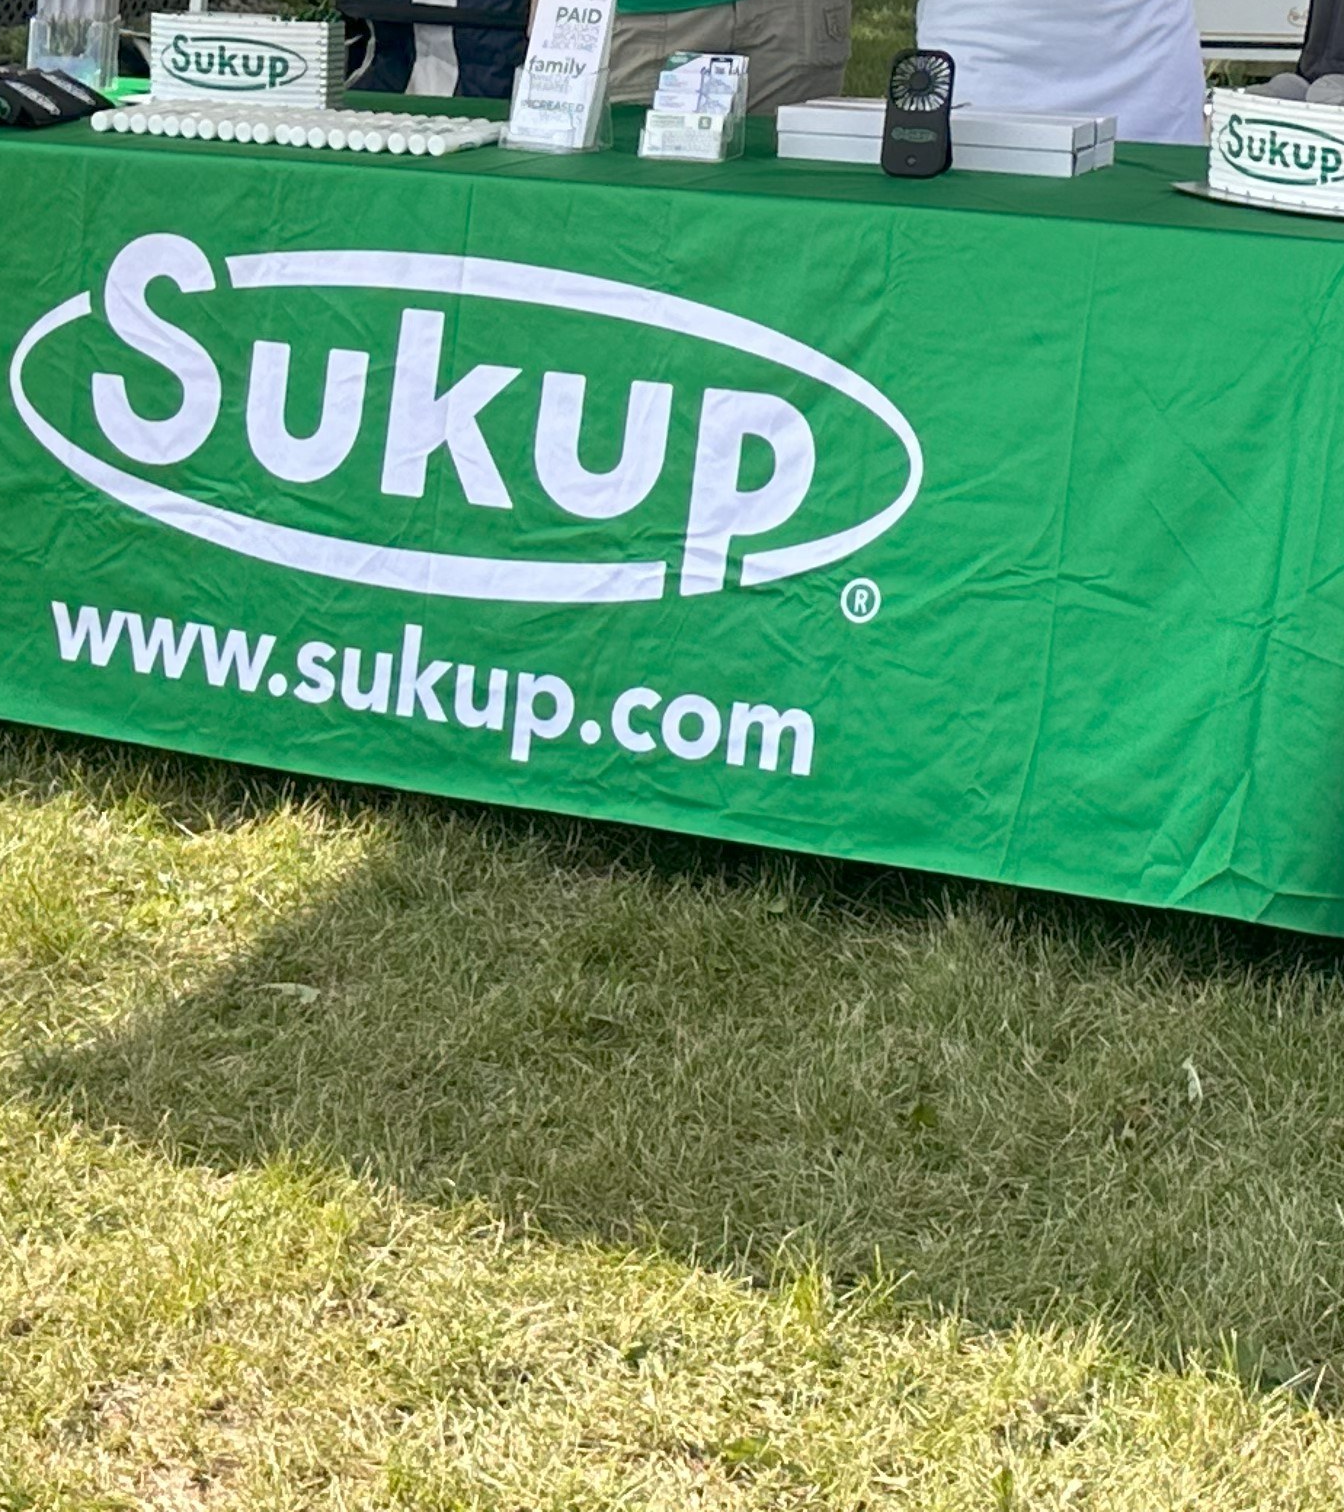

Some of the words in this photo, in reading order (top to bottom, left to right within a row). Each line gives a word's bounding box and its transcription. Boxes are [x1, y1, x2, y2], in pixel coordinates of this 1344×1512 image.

[556, 7, 602, 24] PAID
[172, 34, 290, 88] Sukup
[529, 55, 586, 79] family
[522, 99, 585, 113] INCREASED
[1227, 114, 1342, 184] Sukup
[91, 232, 816, 597] Sukup
[51, 602, 814, 776] www.sukup.com
